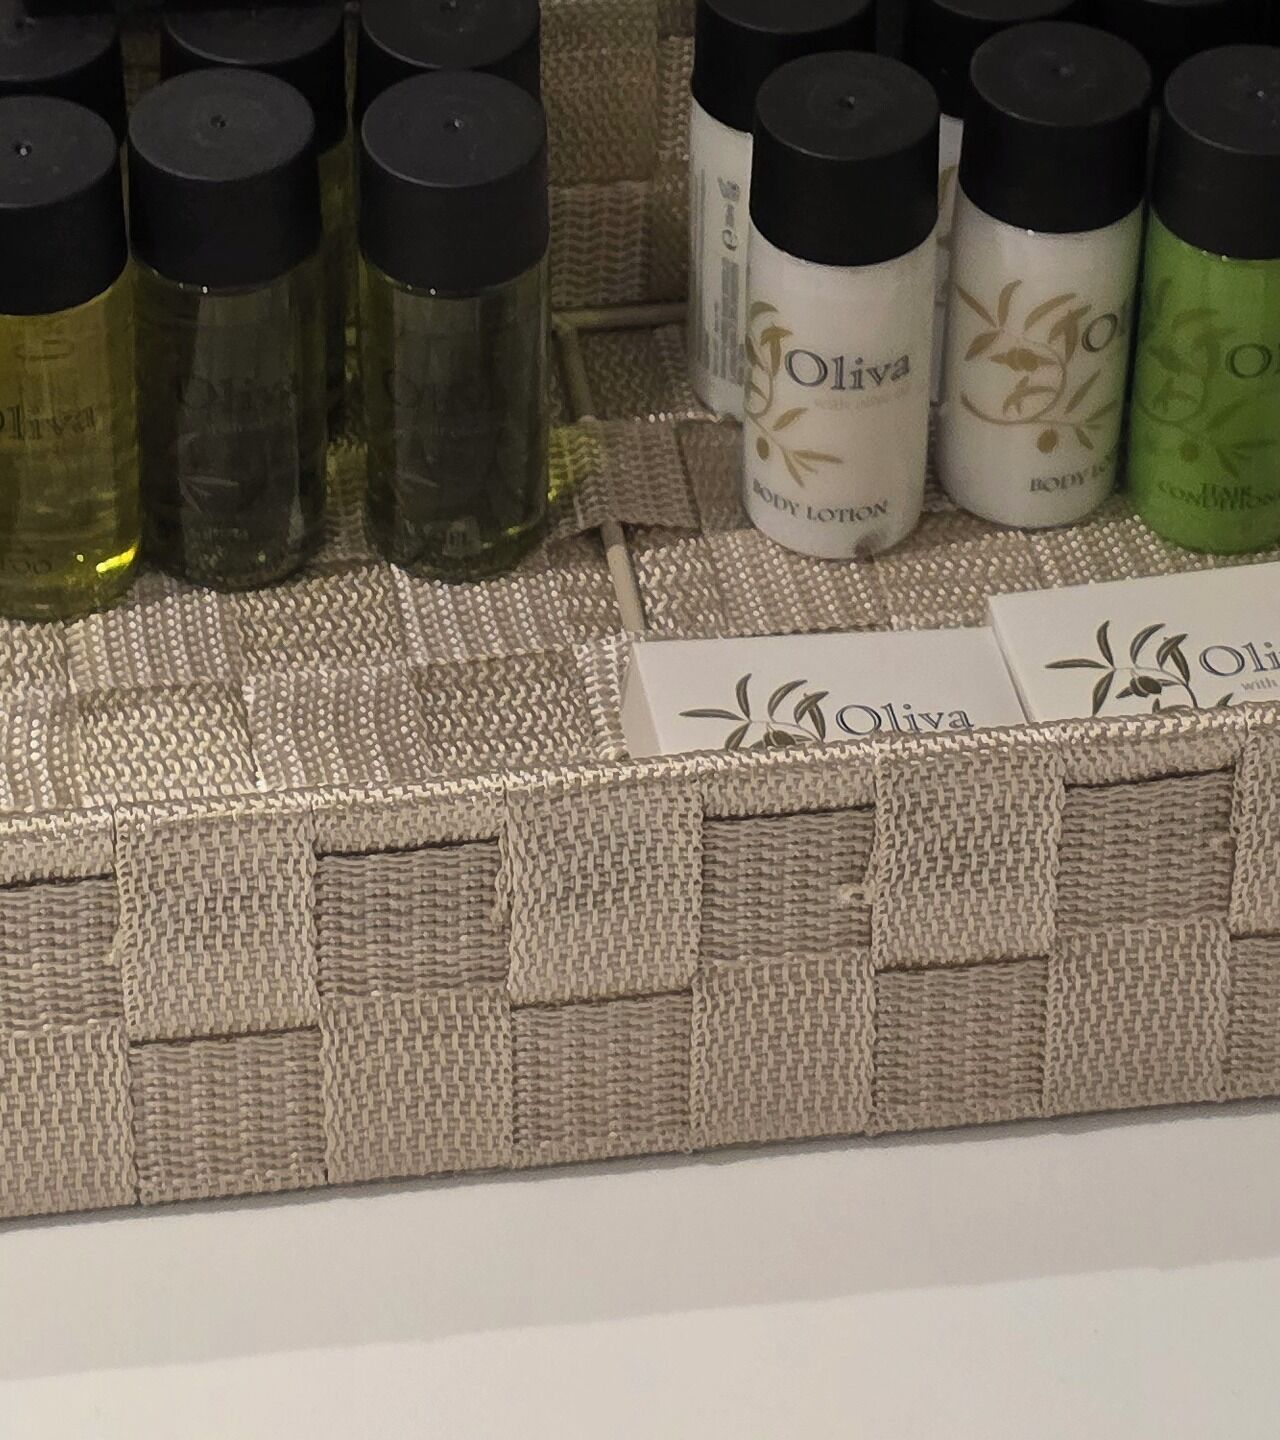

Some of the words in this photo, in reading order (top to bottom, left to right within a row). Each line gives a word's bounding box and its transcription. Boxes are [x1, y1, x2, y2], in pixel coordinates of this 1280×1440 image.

[784, 348, 911, 391] Oliva
[1029, 467, 1090, 493] BODY
[752, 478, 800, 517] BODY
[806, 499, 889, 524] LOTION
[1240, 677, 1278, 692] with
[835, 702, 975, 736] Oliva
